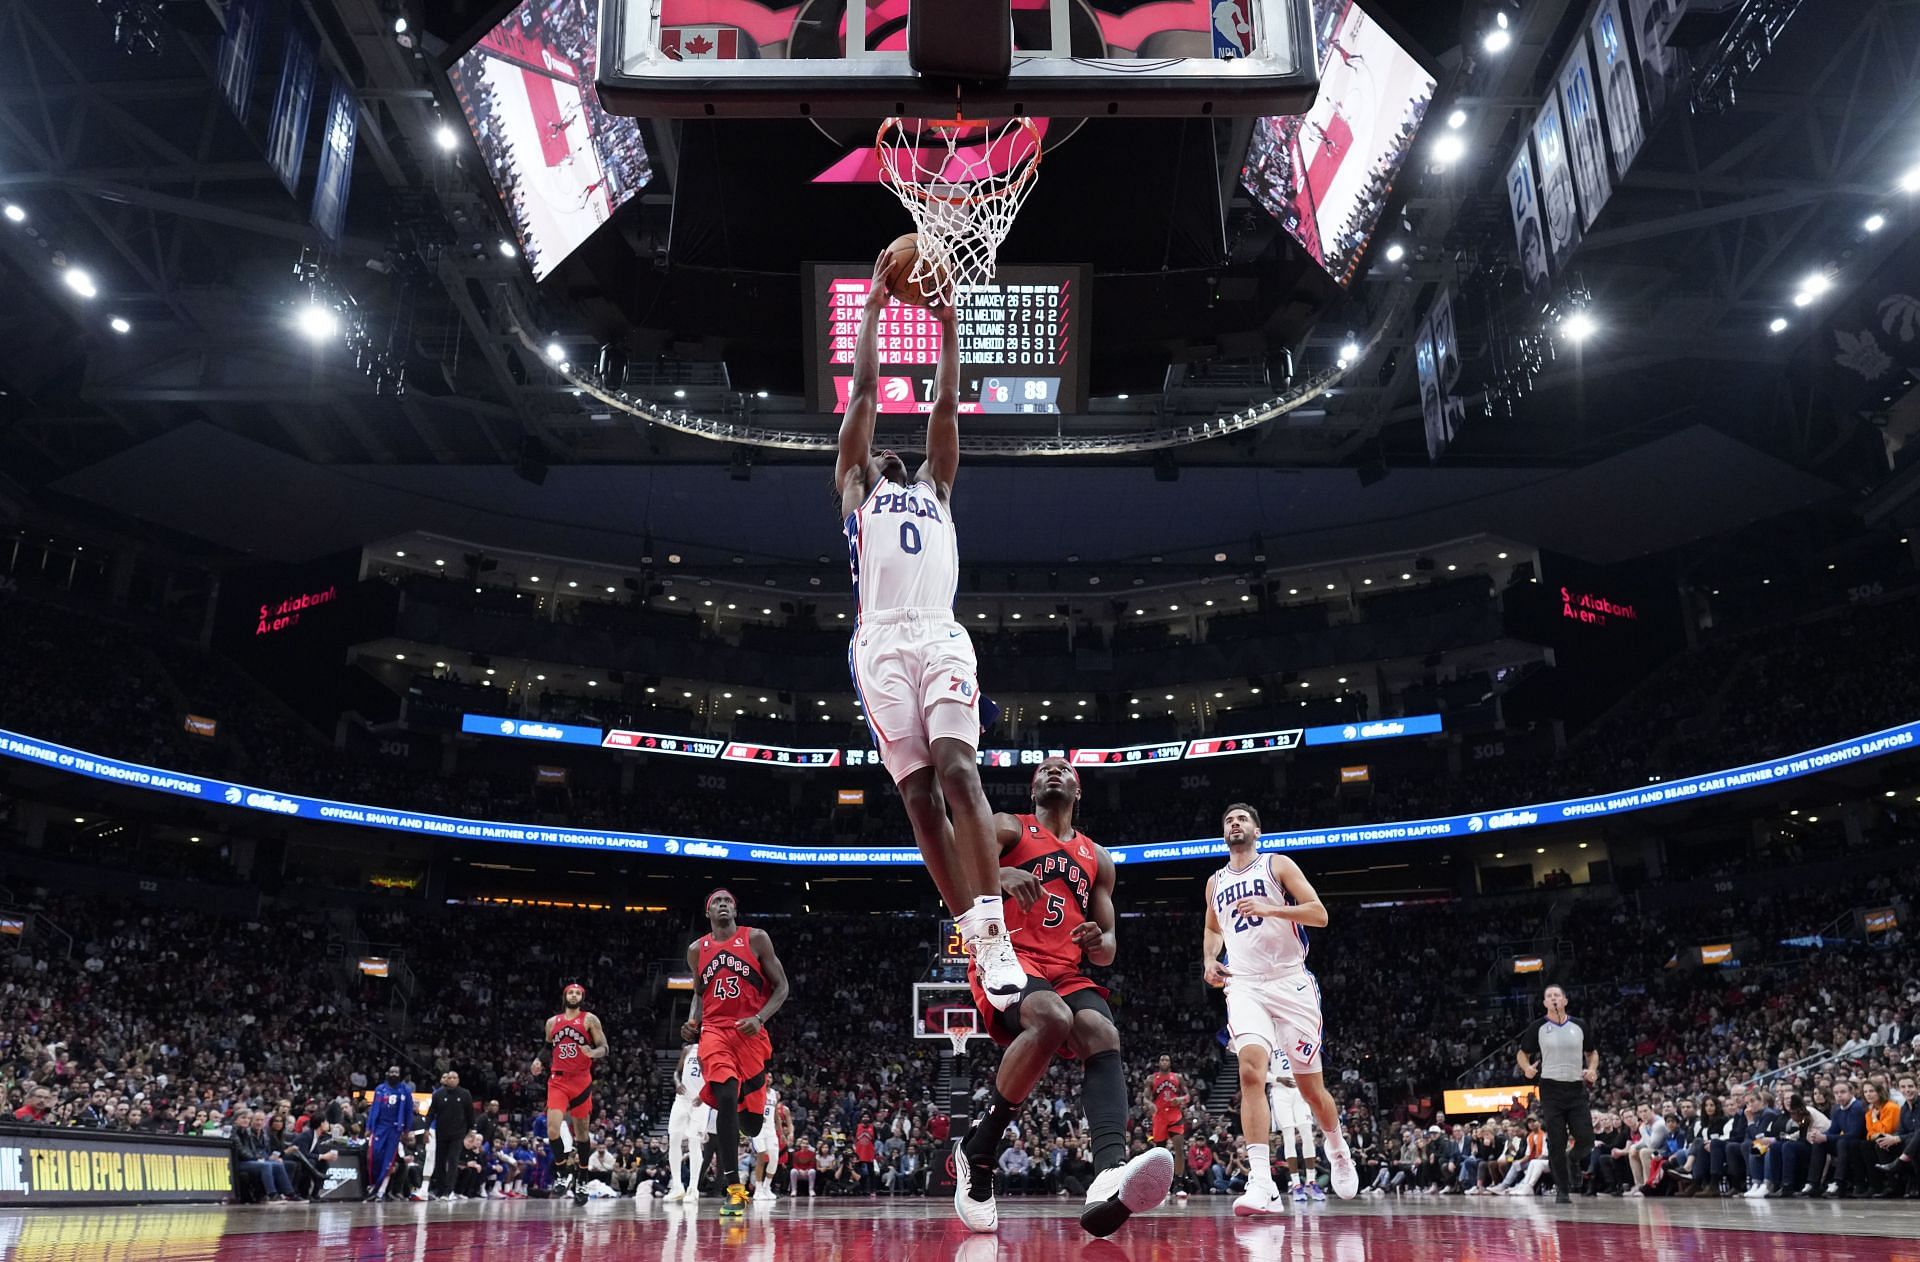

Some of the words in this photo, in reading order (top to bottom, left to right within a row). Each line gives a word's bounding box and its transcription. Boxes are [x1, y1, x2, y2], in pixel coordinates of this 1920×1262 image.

[1218, 48, 1238, 58] NBA
[836, 294, 845, 306] 3
[975, 295, 1006, 306] MAXEY
[1007, 295, 1019, 306] 26
[1022, 295, 1031, 306] 5
[1036, 295, 1044, 306] 5
[1048, 295, 1057, 306] 0
[837, 308, 846, 320] 5
[890, 308, 899, 320] 7
[904, 308, 913, 320] 5
[916, 308, 926, 320] 3
[974, 309, 1005, 321] MELTON
[1009, 309, 1017, 321] 7
[1022, 309, 1030, 321] 2
[1035, 309, 1044, 321] 4
[1048, 309, 1057, 321] 2
[836, 323, 846, 335] 23
[890, 323, 900, 335] 5
[904, 323, 912, 335] 5
[917, 323, 926, 335] 8
[930, 323, 938, 335] 1
[976, 324, 1004, 335] NIANG
[1008, 324, 1017, 335] 3
[1022, 324, 1030, 335] 1
[1035, 324, 1044, 335] 0
[1048, 324, 1057, 335] 0
[836, 337, 847, 349] 33
[890, 337, 901, 349] 22
[904, 337, 913, 349] 0
[917, 337, 926, 349] 0
[930, 337, 938, 349] 1
[1007, 338, 1018, 349] 29
[1022, 338, 1030, 349] 5
[1034, 338, 1043, 349] 3
[1048, 338, 1055, 349] 1
[836, 351, 847, 363] 43
[890, 351, 901, 363] 20
[904, 351, 913, 363] 4
[917, 351, 926, 363] 9
[930, 351, 938, 363] 1
[972, 352, 995, 364] HOUSE
[1008, 352, 1017, 364] 3
[1021, 352, 1030, 364] 0
[1034, 352, 1044, 364] 0
[1048, 352, 1055, 364] 1
[1025, 380, 1047, 400] 89
[900, 521, 922, 555] 0
[949, 676, 972, 697] 76
[1277, 736, 1290, 746] 23
[812, 754, 824, 763] 23
[1021, 751, 1043, 764] 89
[9, 740, 58, 762] PARTNER
[59, 754, 74, 766] OF
[76, 758, 94, 772] THE
[95, 763, 150, 783] TORONTO
[151, 775, 201, 794] RAPTORS
[1562, 800, 1606, 816] OFFICIAL
[1608, 795, 1639, 810] SHAVE
[1640, 792, 1663, 804] AND
[1665, 784, 1698, 799] BEARD
[1699, 778, 1725, 792] CARE
[1726, 767, 1773, 787] PARTNER
[1774, 764, 1789, 776] OF
[1790, 760, 1808, 772] THE
[1809, 746, 1861, 768] TORONTO
[1862, 732, 1913, 754] RAPTORS
[697, 774, 727, 790] 302
[1180, 774, 1210, 789] 304
[247, 793, 299, 814] Gillette
[320, 807, 364, 822] OFFICIAL
[366, 813, 398, 826] SHAVE
[399, 818, 422, 829] AND
[424, 821, 455, 833] BEARD
[456, 825, 481, 836] CARE
[483, 828, 524, 839] PARTNER
[526, 832, 538, 841] OF
[540, 833, 557, 842] THE
[559, 834, 605, 846] TORONTO
[606, 838, 648, 849] RAPTORS
[1489, 811, 1537, 829] Gillette
[1263, 838, 1286, 848] CARE
[1287, 835, 1326, 847] PARTNER
[1327, 833, 1340, 843] OF
[1342, 832, 1358, 842] THE
[1360, 828, 1406, 840] TORONTO
[1408, 824, 1451, 837] RAPTORS
[684, 842, 729, 858] Gillette
[751, 849, 788, 860] OFFICIAL
[789, 852, 817, 862] SHAVE
[818, 852, 839, 862] AND
[839, 853, 867, 862] BEARD
[869, 853, 891, 862] CARE
[892, 853, 924, 862] PARTNE
[1144, 848, 1181, 858] OFFICIAL
[1182, 845, 1210, 856] SHAVE
[1032, 856, 1088, 908] APTORS
[1216, 878, 1267, 912] PHILA
[1042, 893, 1066, 928] 5
[703, 954, 749, 984] RAPTORS
[714, 976, 740, 1000] 43
[559, 1042, 577, 1059] 33
[1296, 1038, 1313, 1056] 76
[30, 1149, 69, 1191] THEN
[70, 1151, 91, 1191] GO
[92, 1152, 123, 1191] EPIC
[124, 1152, 143, 1191] ON
[143, 1154, 176, 1191] YOUR
[175, 1155, 232, 1191] DOWNTIME
